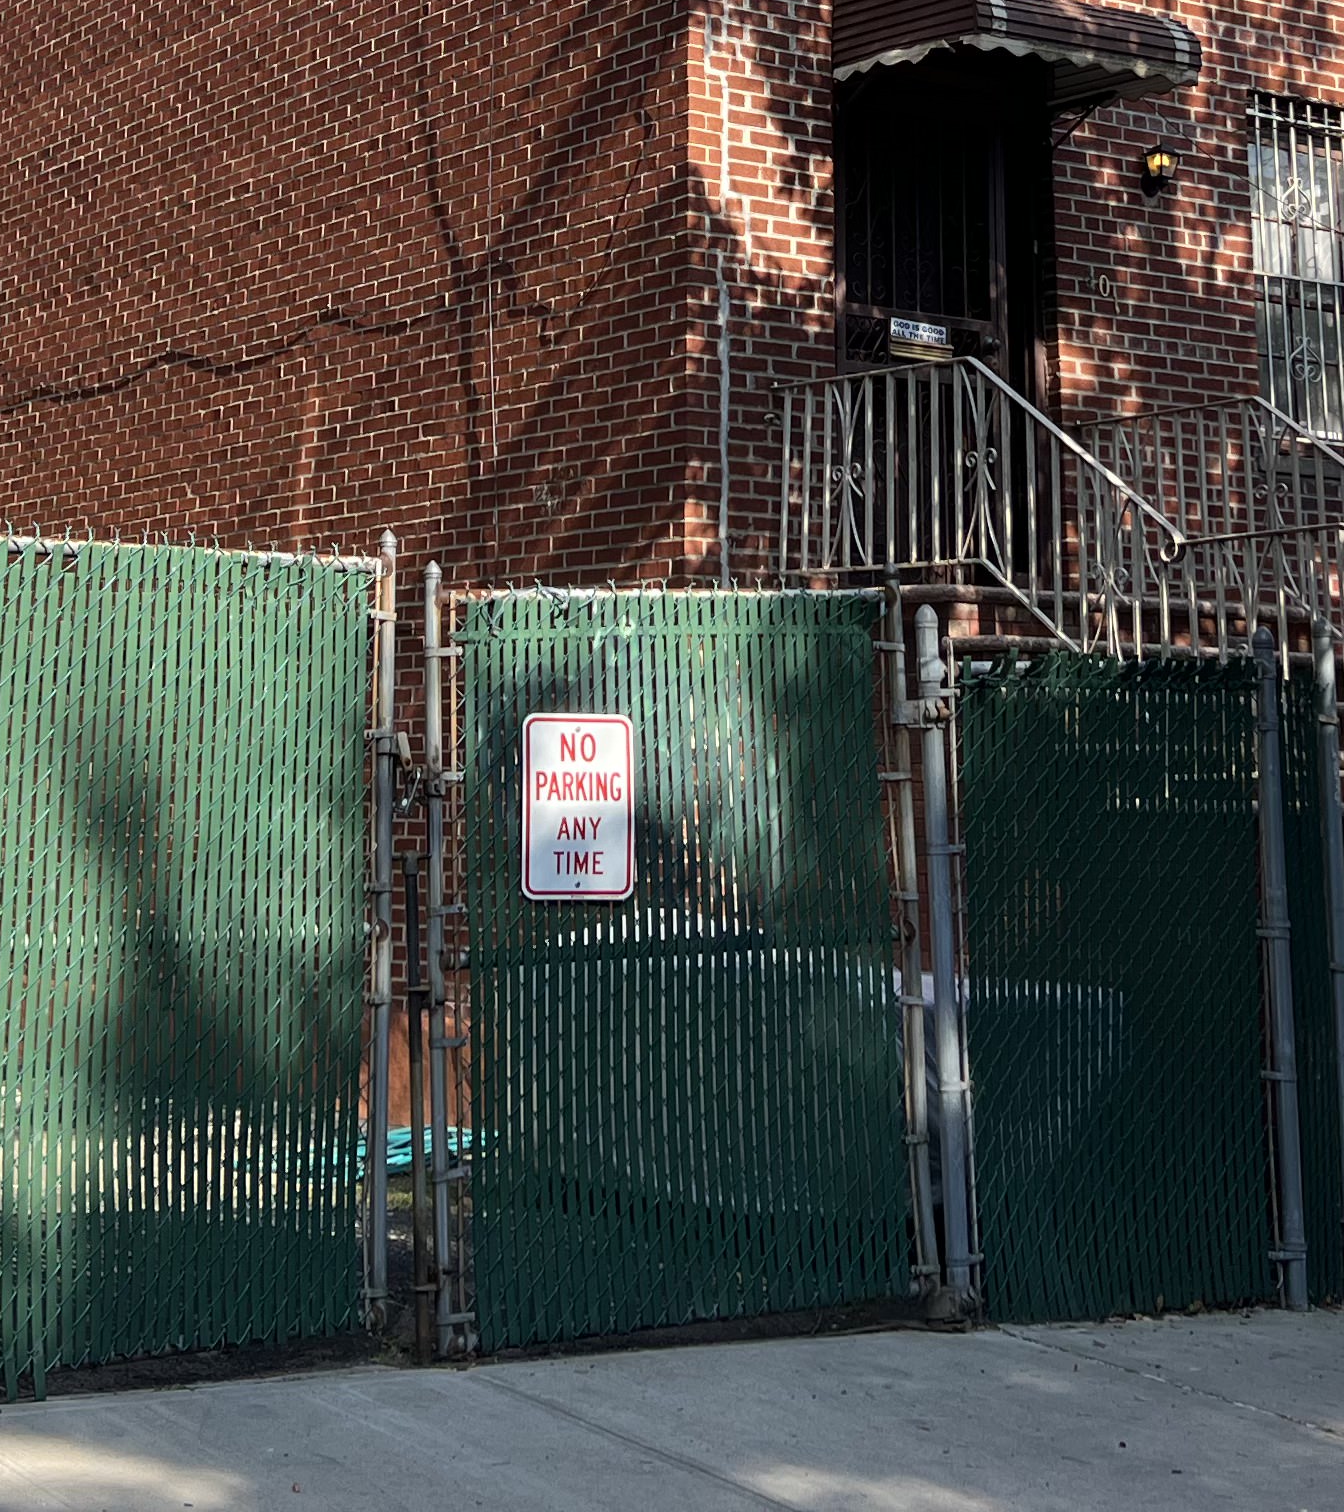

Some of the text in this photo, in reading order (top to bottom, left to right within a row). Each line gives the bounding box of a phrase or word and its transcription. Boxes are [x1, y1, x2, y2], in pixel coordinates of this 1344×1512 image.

[892, 329, 945, 345] ALL THE TIME
[893, 320, 945, 336] GOD IS GOOD
[560, 733, 597, 763] NO
[535, 771, 622, 802] PARKING
[557, 816, 602, 841] ANY
[553, 851, 604, 876] TIME
